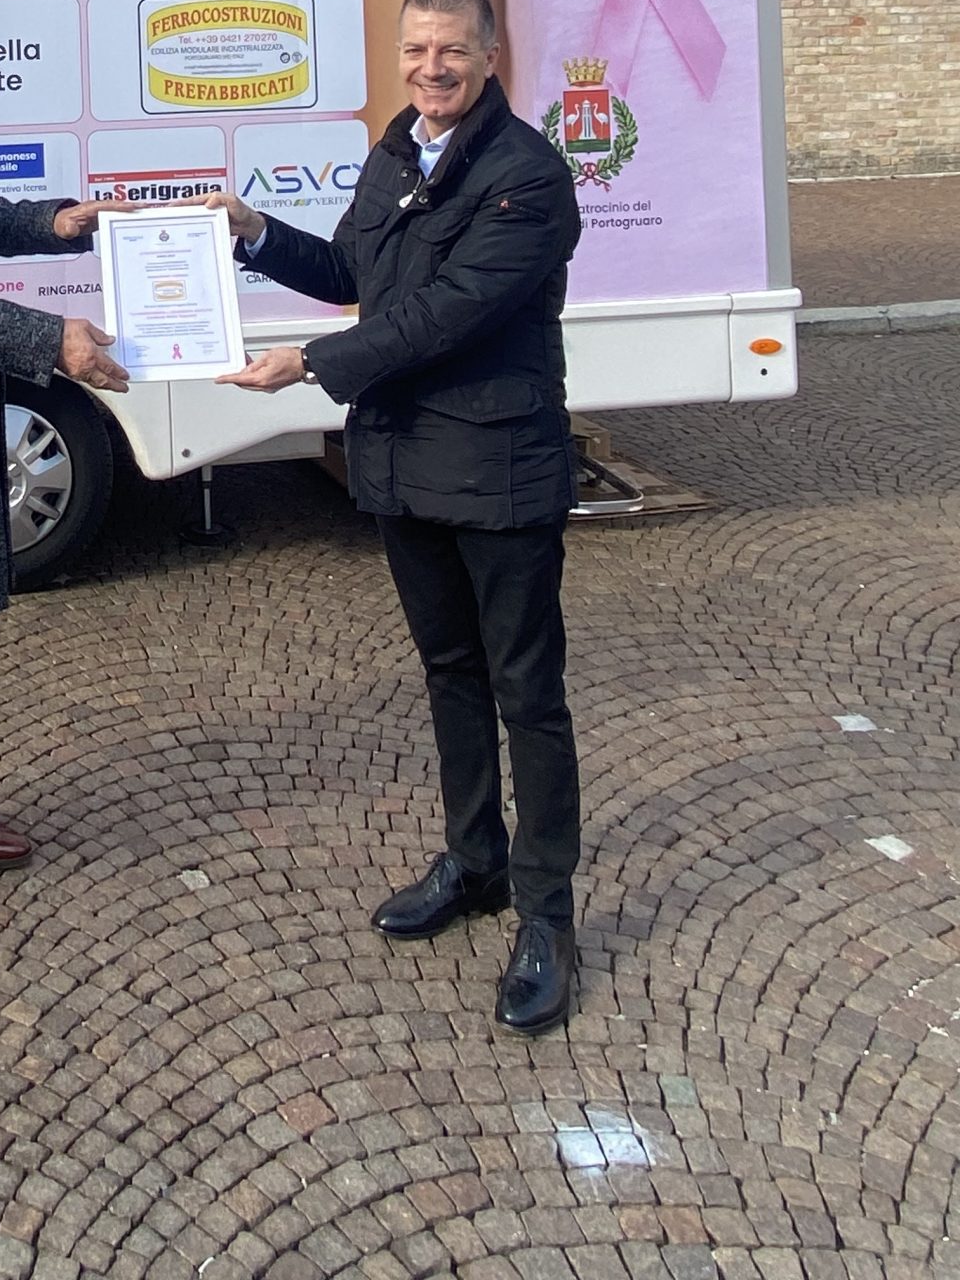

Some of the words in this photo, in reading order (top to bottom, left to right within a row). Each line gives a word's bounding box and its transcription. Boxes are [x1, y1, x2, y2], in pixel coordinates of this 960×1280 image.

[151, 6, 304, 38] FERROCOSTRUZIONI
[220, 34, 242, 43] 0421
[180, 45, 220, 55] MODULARE
[221, 44, 285, 54] INDUSTRIALIZZATA
[164, 75, 295, 101] PREFABBRICATI
[241, 161, 364, 198] ASVO
[253, 198, 293, 209] GRUPPO
[578, 202, 630, 215] atrocinio
[632, 200, 651, 212] del
[591, 216, 662, 231] Portogruaro
[38, 282, 103, 297] RINGRAZIA
